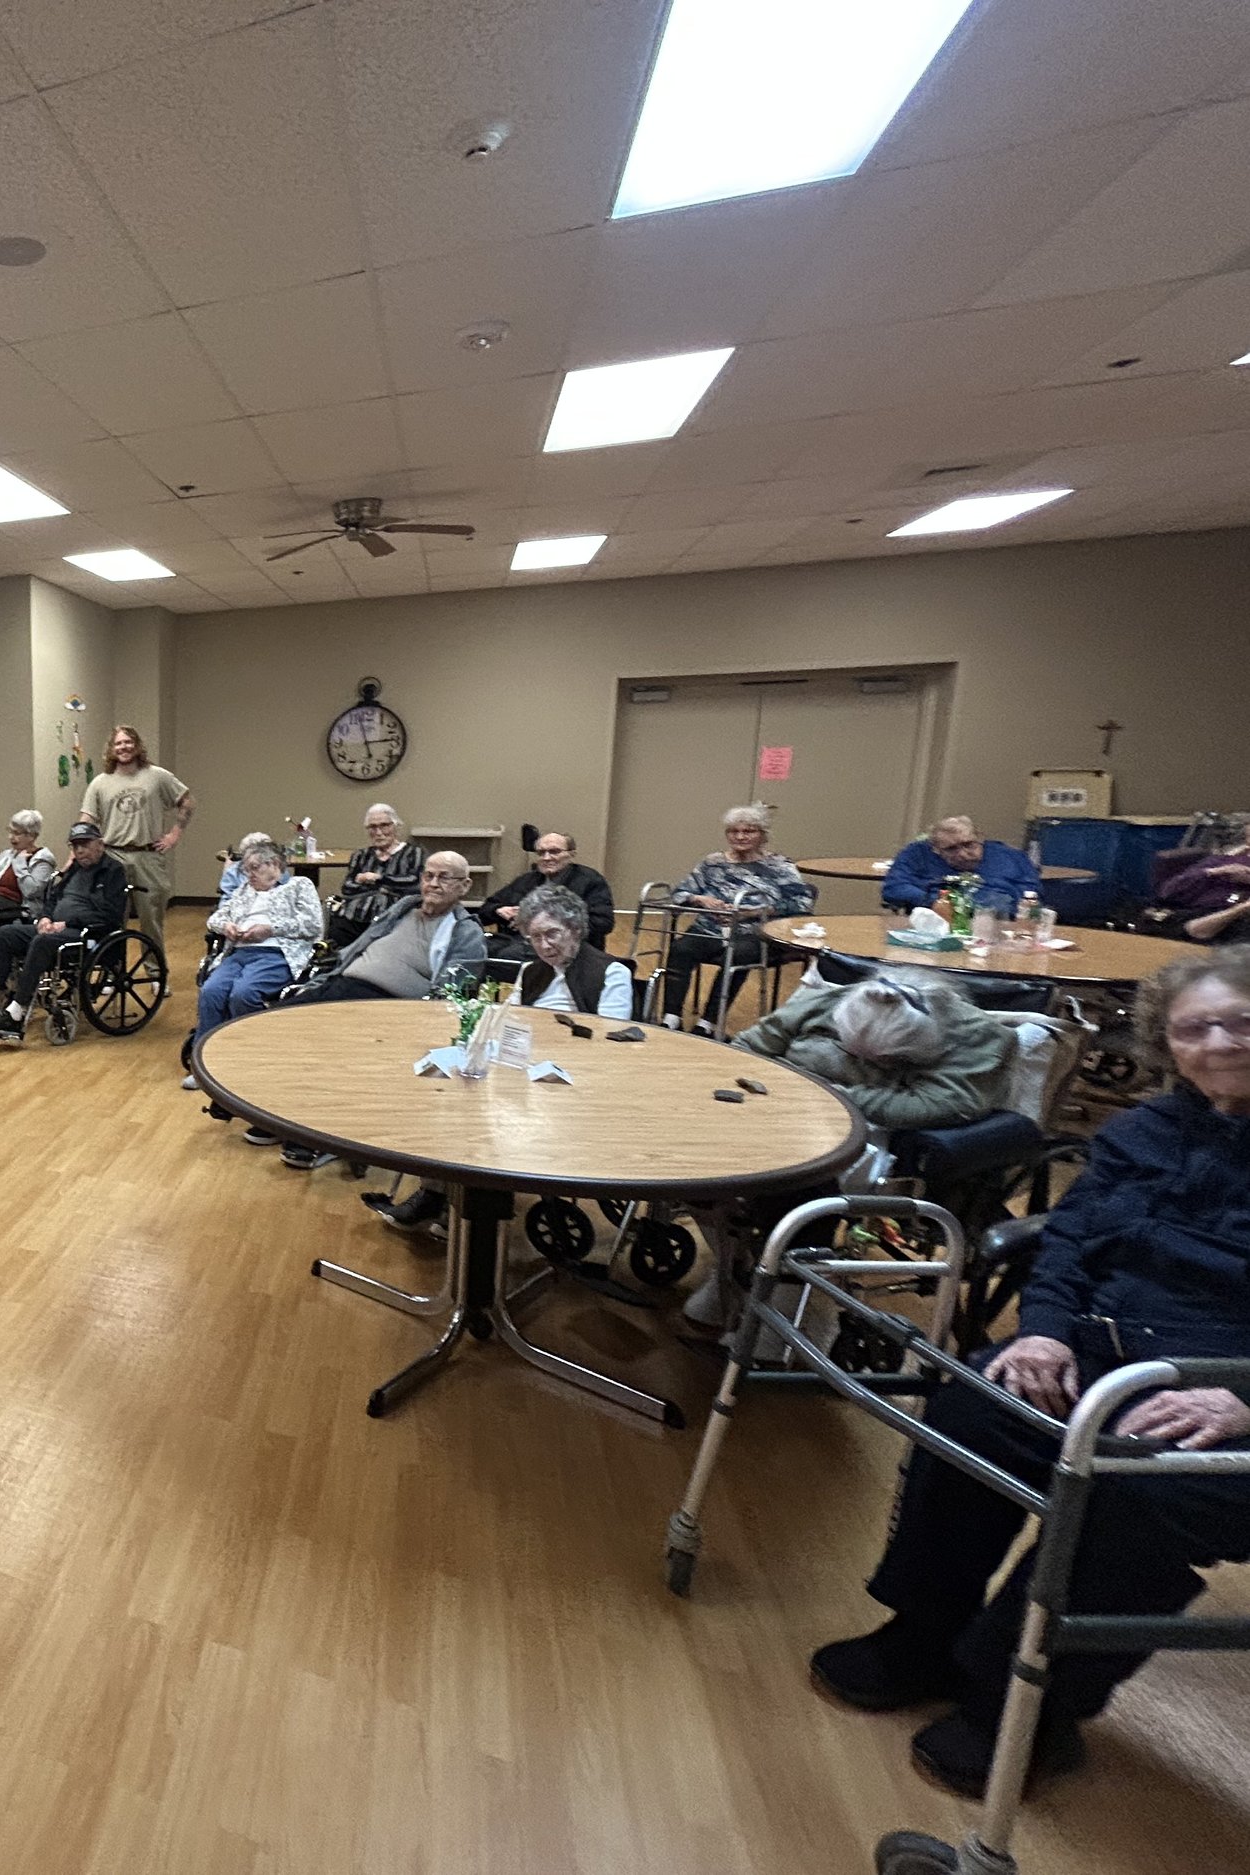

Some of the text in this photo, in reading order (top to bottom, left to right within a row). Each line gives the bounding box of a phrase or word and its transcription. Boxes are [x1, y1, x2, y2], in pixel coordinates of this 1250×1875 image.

[380, 711, 384, 726] 1
[386, 721, 397, 734] 2
[334, 736, 343, 749] 9
[389, 734, 400, 749] 3
[361, 763, 371, 775] 6
[375, 759, 386, 773] 5
